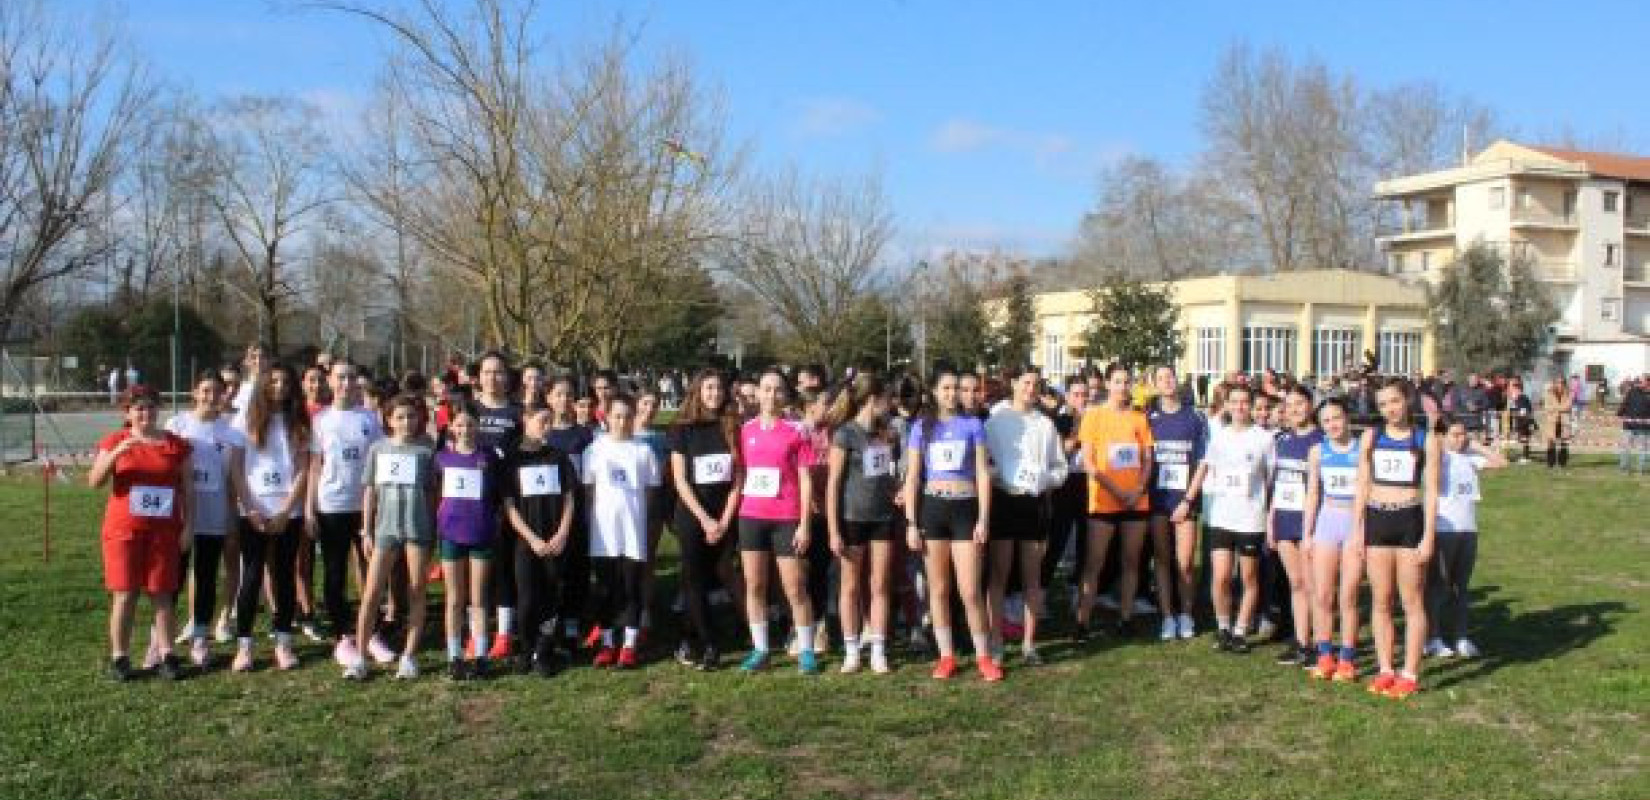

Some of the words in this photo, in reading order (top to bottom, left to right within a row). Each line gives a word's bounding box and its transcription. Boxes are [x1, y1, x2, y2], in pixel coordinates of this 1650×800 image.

[390, 462, 400, 476] 2
[536, 473, 545, 487] 4
[141, 493, 160, 509] 84
